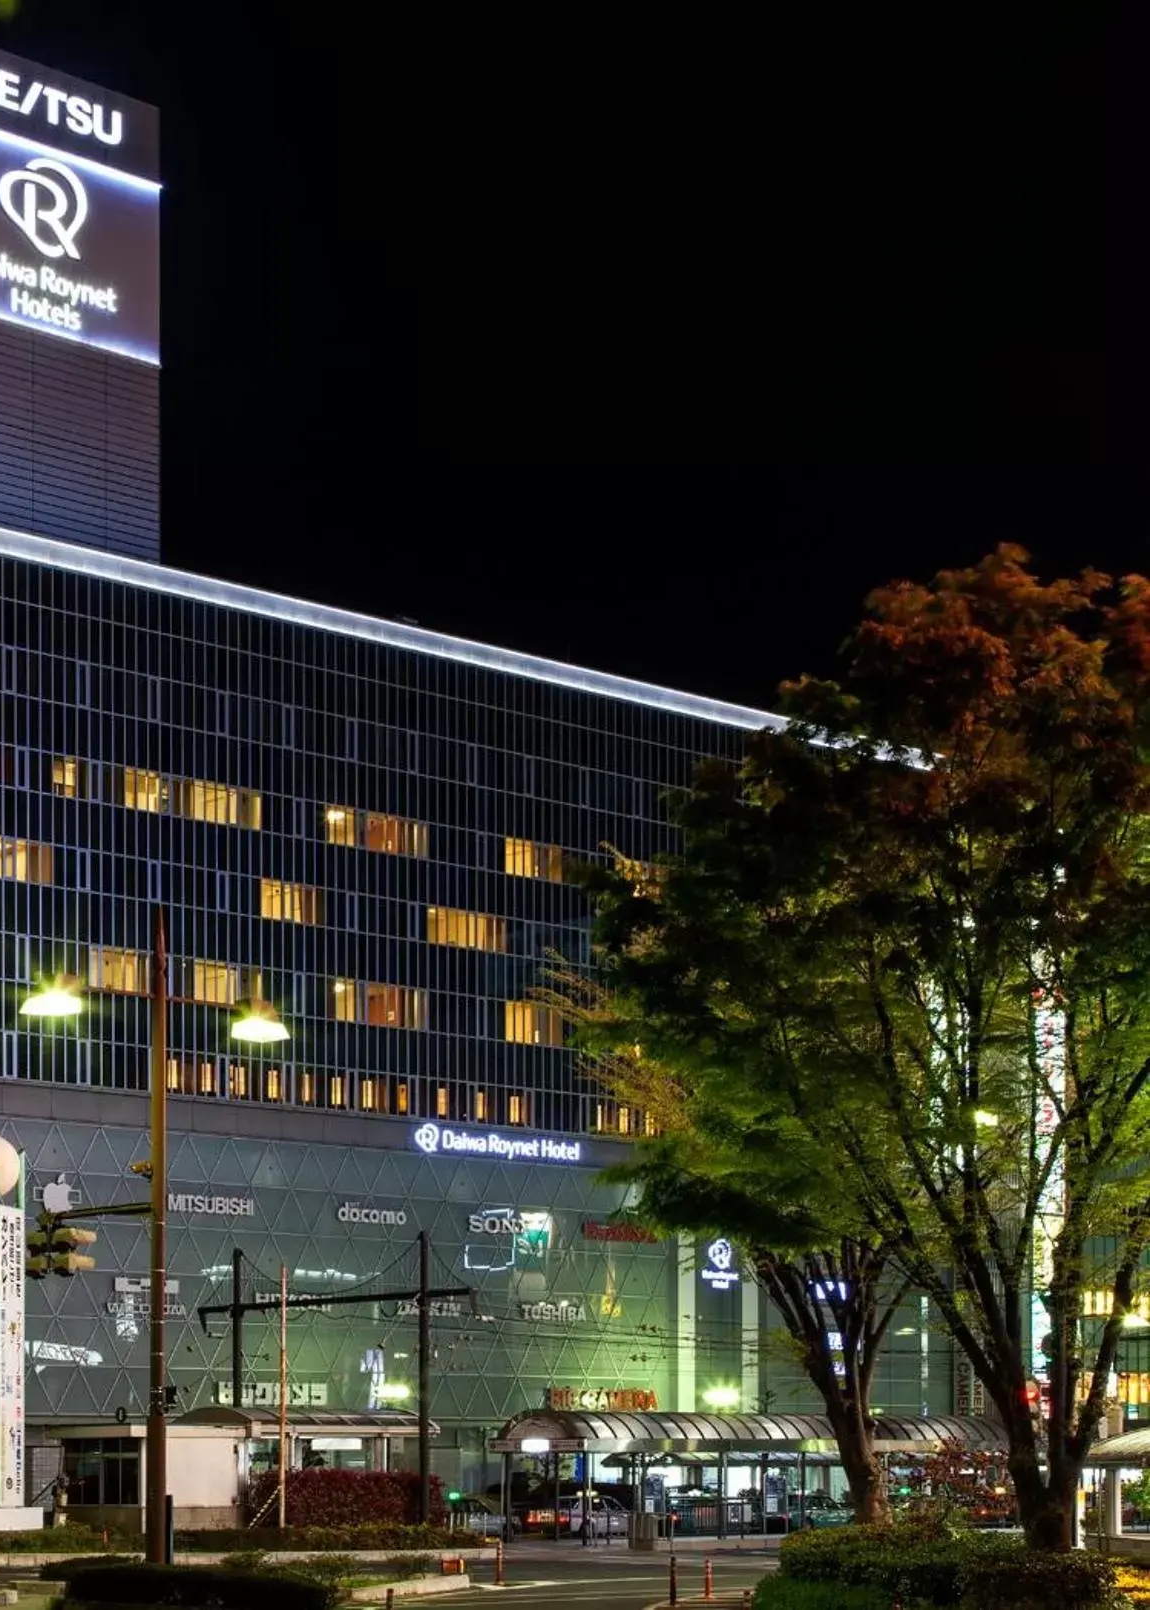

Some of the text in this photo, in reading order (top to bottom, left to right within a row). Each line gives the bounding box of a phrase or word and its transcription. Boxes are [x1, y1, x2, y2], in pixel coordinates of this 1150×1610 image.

[40, 265, 118, 314] Roynet
[10, 287, 81, 331] Hotels
[442, 1129, 486, 1153] Daiwa
[488, 1134, 539, 1160] Roynet
[541, 1139, 580, 1161] Hotel
[168, 1193, 254, 1216] MITSUBISHI
[338, 1201, 406, 1225] docomo
[397, 1300, 461, 1316] DAKIN
[522, 1303, 587, 1321] TOSHIBA
